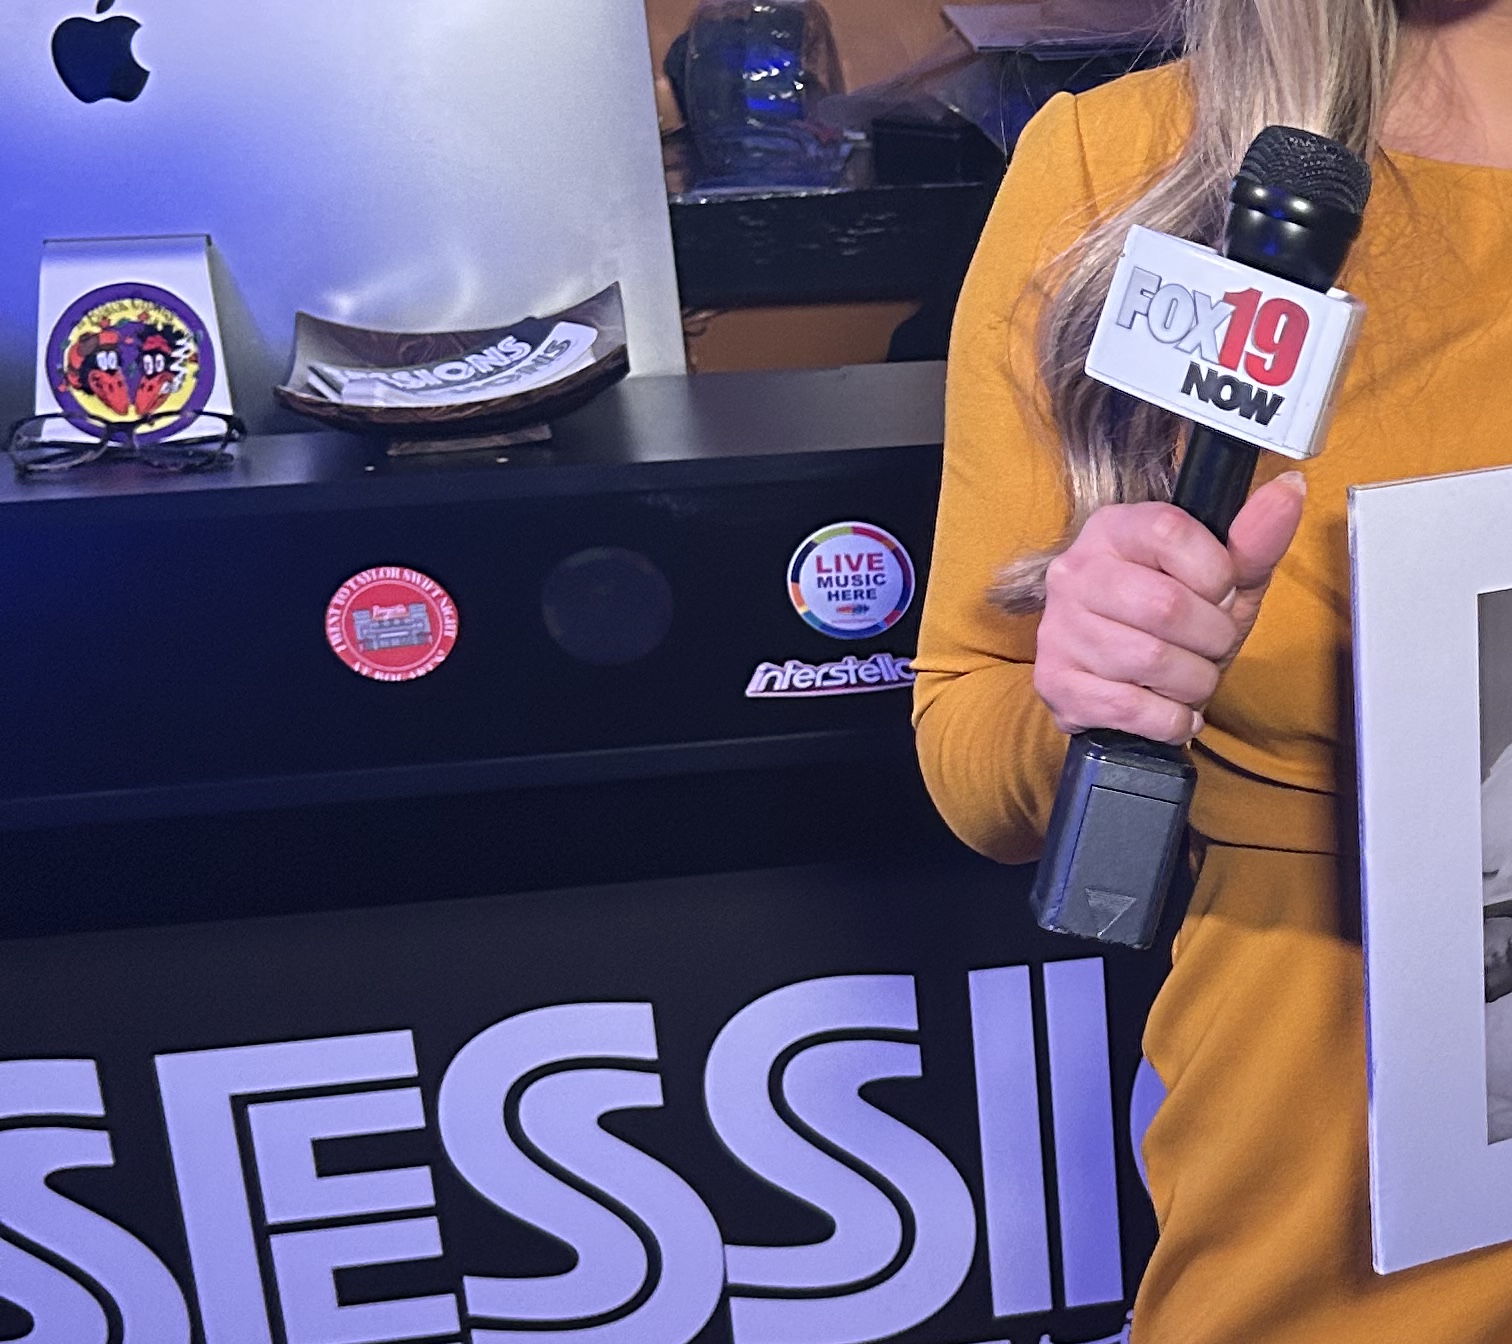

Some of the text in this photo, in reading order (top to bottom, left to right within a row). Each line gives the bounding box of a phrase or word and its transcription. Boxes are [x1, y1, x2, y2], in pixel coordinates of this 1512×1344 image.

[1180, 361, 1285, 426] NOW
[815, 552, 885, 574] LIVE
[816, 572, 887, 589] MUSIC
[346, 566, 401, 591] TAYLOR
[403, 567, 442, 598] SWIFT
[440, 596, 458, 640] NIGHT
[827, 588, 878, 602] HERE
